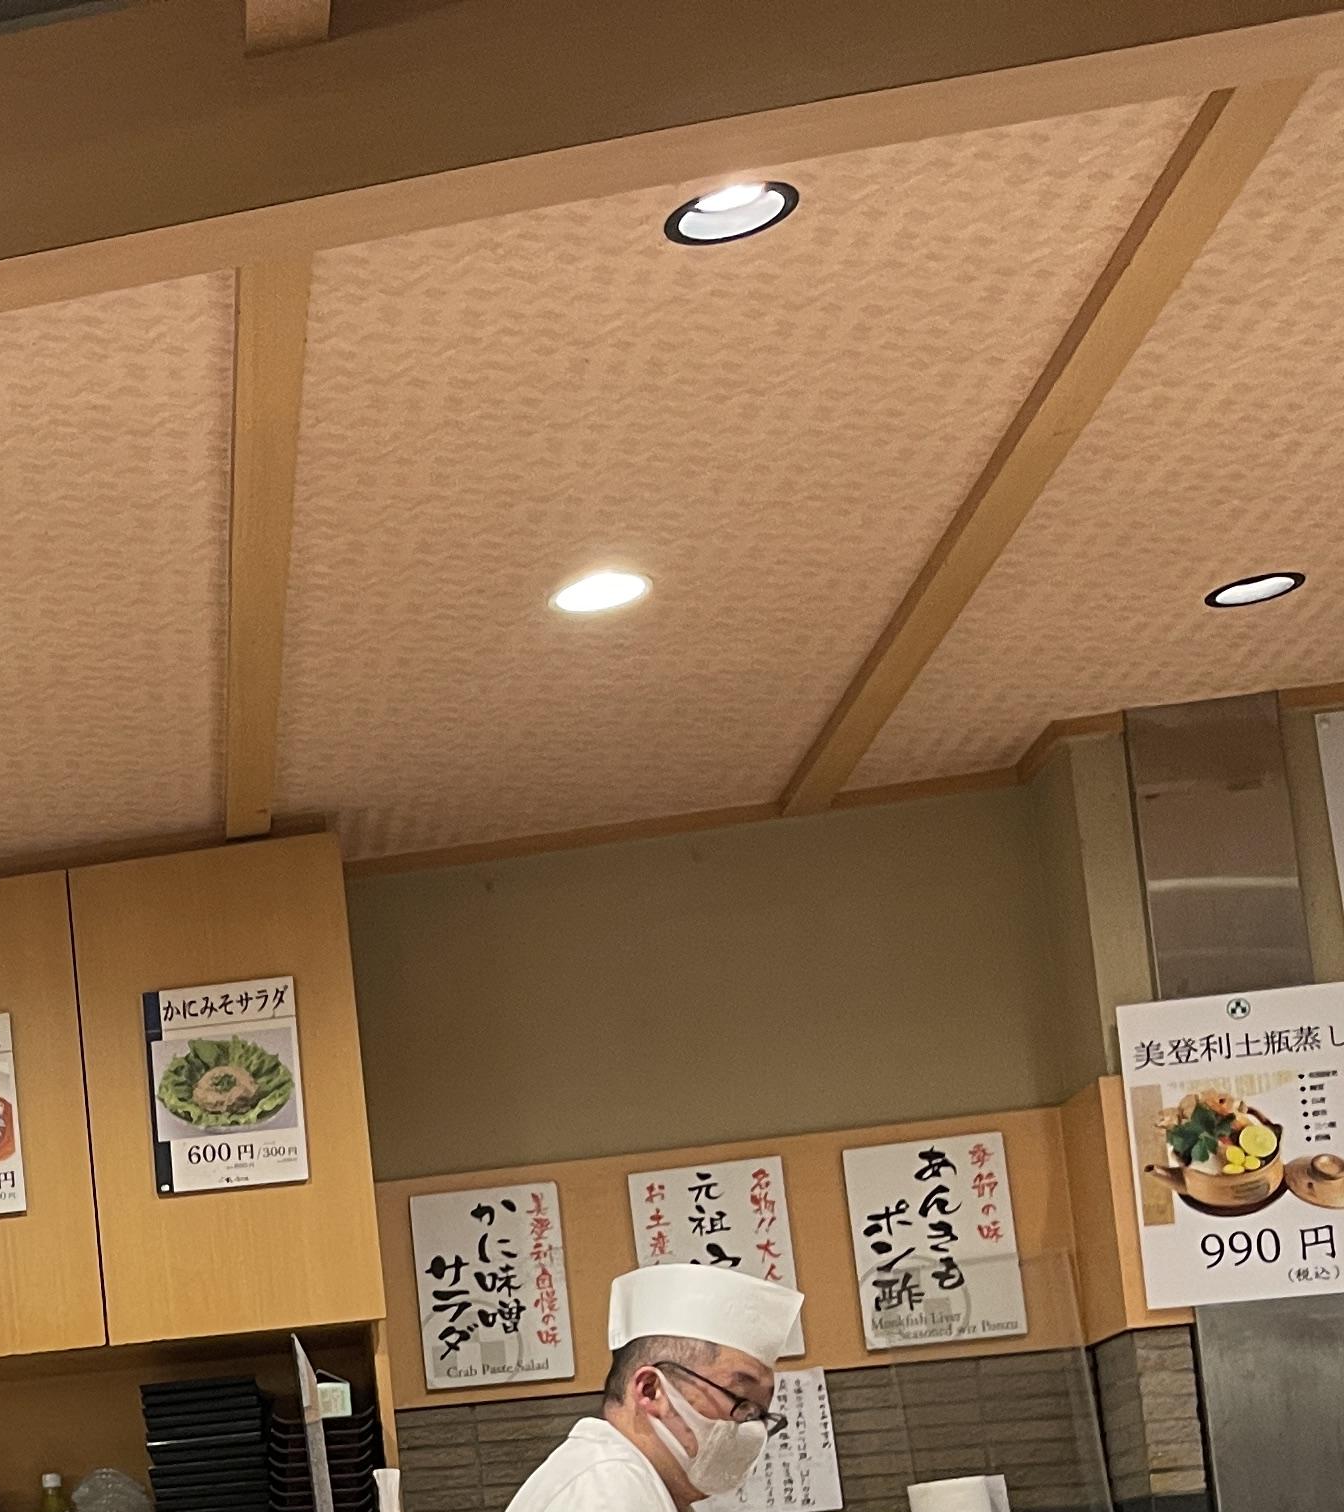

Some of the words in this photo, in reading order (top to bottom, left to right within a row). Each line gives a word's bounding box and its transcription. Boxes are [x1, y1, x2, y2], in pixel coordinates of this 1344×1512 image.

[162, 985, 289, 1021] かにみそサラダ
[1133, 1025, 1344, 1071] 美登利土瓶蒸し
[914, 1145, 965, 1290] あんきも
[967, 1143, 1004, 1243] 季節の味
[470, 1198, 527, 1334] かに味噌
[525, 1192, 562, 1348] 美登利自慢の味
[863, 1198, 925, 1311] ポン酢
[1287, 1265, 1341, 1283] (税込)
[425, 1255, 479, 1360] サラダ
[446, 1365, 477, 1378] Crab
